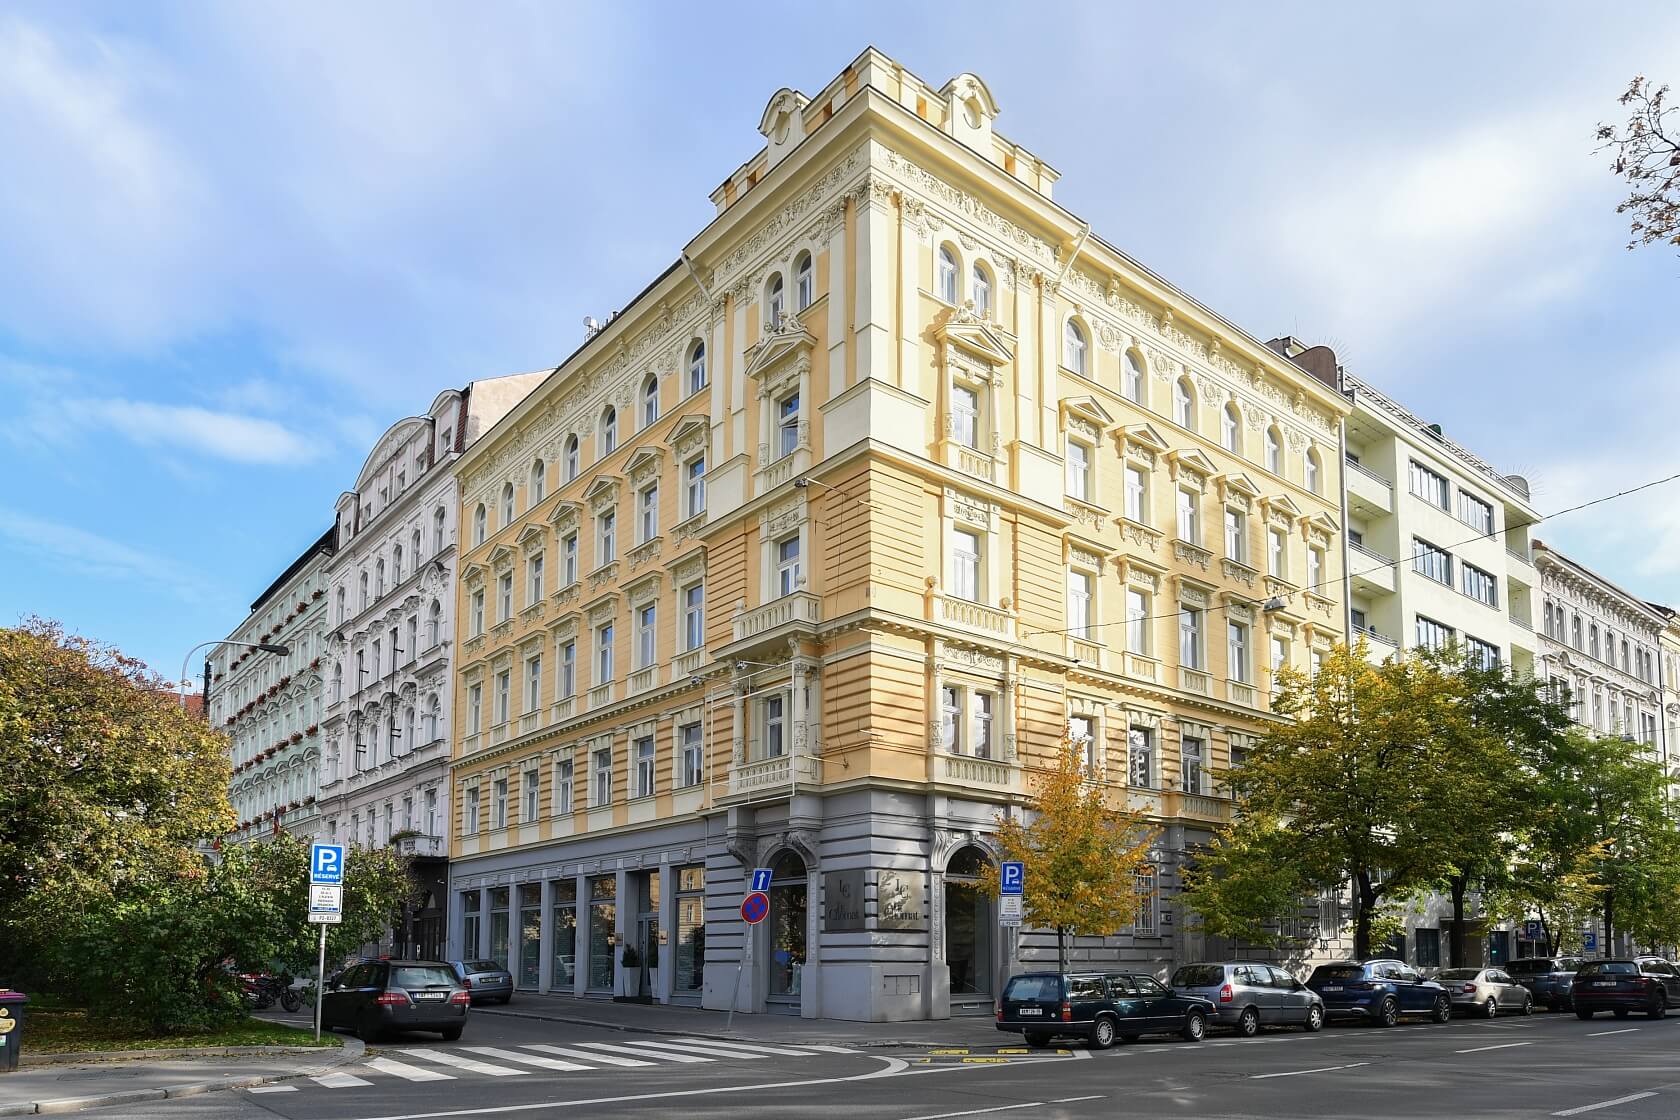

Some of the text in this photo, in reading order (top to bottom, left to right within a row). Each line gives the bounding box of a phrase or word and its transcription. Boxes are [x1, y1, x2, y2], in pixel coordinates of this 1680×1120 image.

[318, 848, 337, 872] P
[1006, 866, 1019, 885] P
[1527, 922, 1538, 934] P
